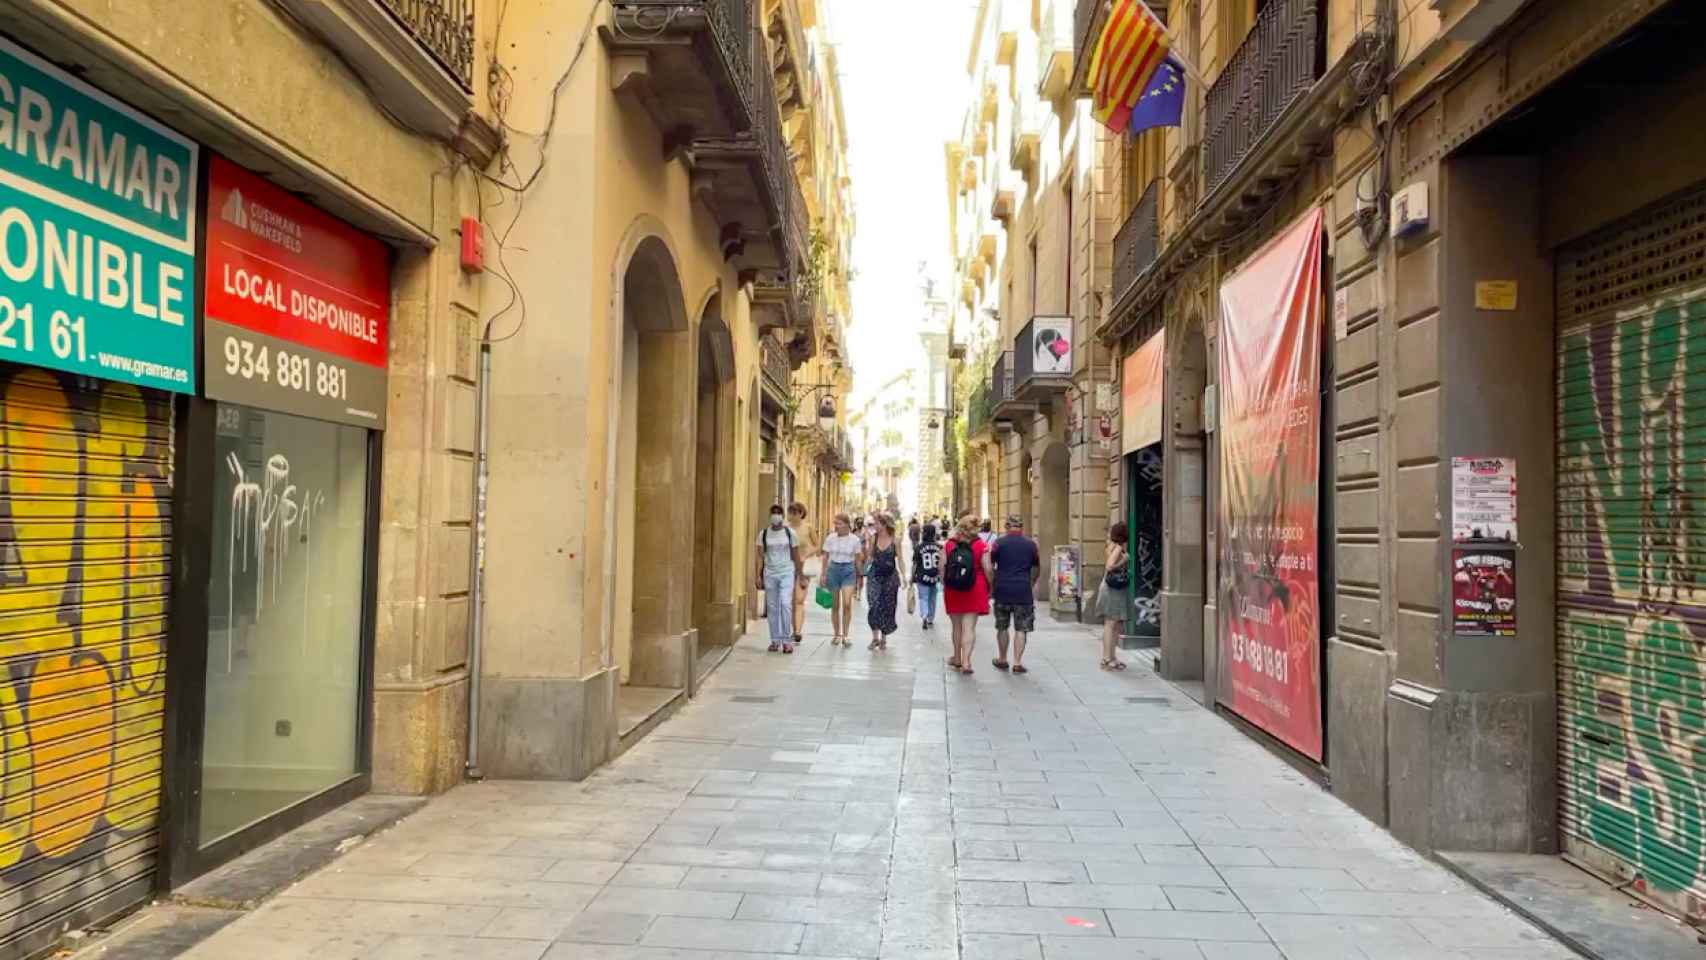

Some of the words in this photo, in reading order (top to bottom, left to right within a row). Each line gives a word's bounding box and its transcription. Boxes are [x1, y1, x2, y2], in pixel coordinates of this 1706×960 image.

[0, 206, 185, 326] ONIBLE
[249, 218, 302, 254] WAKEFIELD
[0, 296, 34, 352] 21
[50, 310, 86, 362] 61
[99, 351, 188, 383] www.gramar.es
[223, 263, 287, 313] LOCAL
[290, 289, 378, 345] DISPONIBLE
[224, 336, 270, 383] 934
[276, 351, 311, 393] 881
[316, 362, 347, 401] 881
